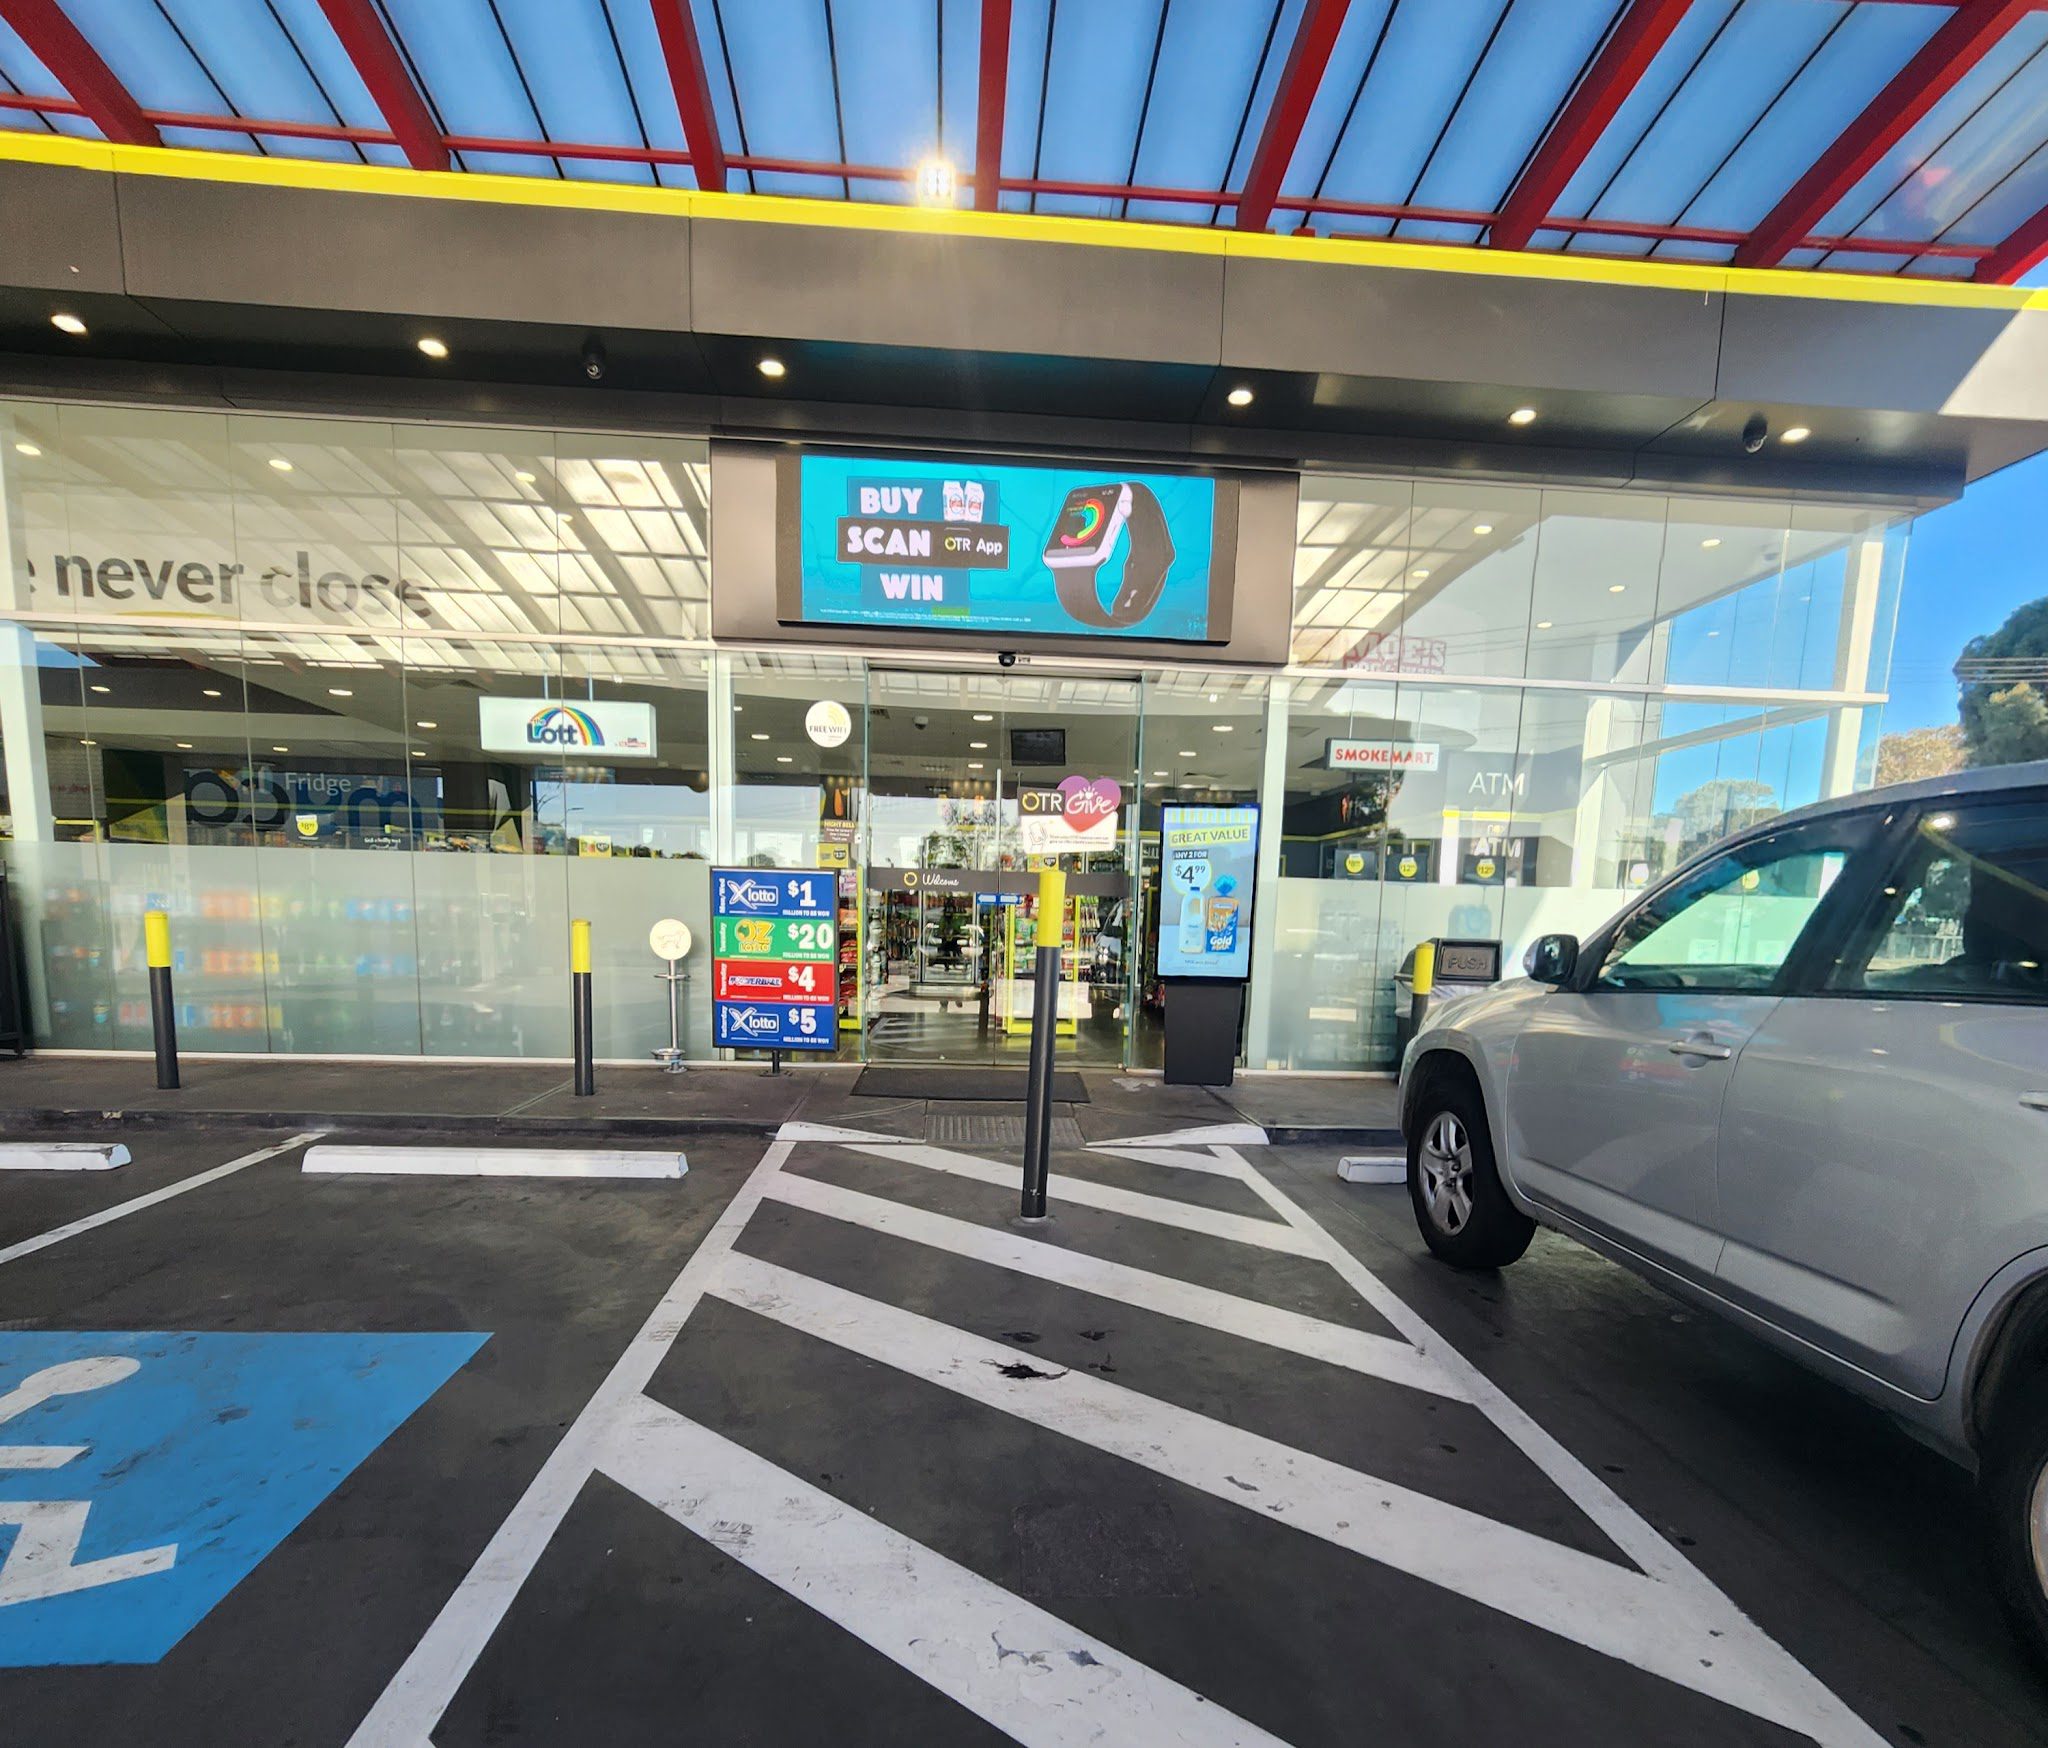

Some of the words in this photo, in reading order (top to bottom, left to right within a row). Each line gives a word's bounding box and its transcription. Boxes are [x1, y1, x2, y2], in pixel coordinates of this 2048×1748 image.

[860, 486, 923, 514] BUY
[847, 526, 931, 557] SCAN
[945, 536, 971, 552] OTR
[976, 538, 1003, 556] App
[54, 553, 244, 604] never
[260, 550, 432, 618] close
[879, 573, 943, 601] WIN
[526, 722, 578, 745] Lott
[809, 725, 827, 733] FREE
[1335, 747, 1434, 765] SMOKEMART
[285, 773, 352, 796] Fridge
[1468, 771, 1526, 796] ATM
[1021, 791, 1063, 812] OTR
[1171, 831, 1208, 844] GREAT
[1210, 828, 1248, 841] VALUE
[1473, 836, 1523, 858] ATM
[922, 873, 960, 886] Welcome
[787, 879, 817, 907] $1
[735, 918, 775, 944] OZ
[787, 923, 834, 950] $20
[1210, 934, 1233, 947] Gold
[1448, 957, 1488, 970] PUSH
[787, 965, 816, 993] $4
[788, 1007, 817, 1035] $5
